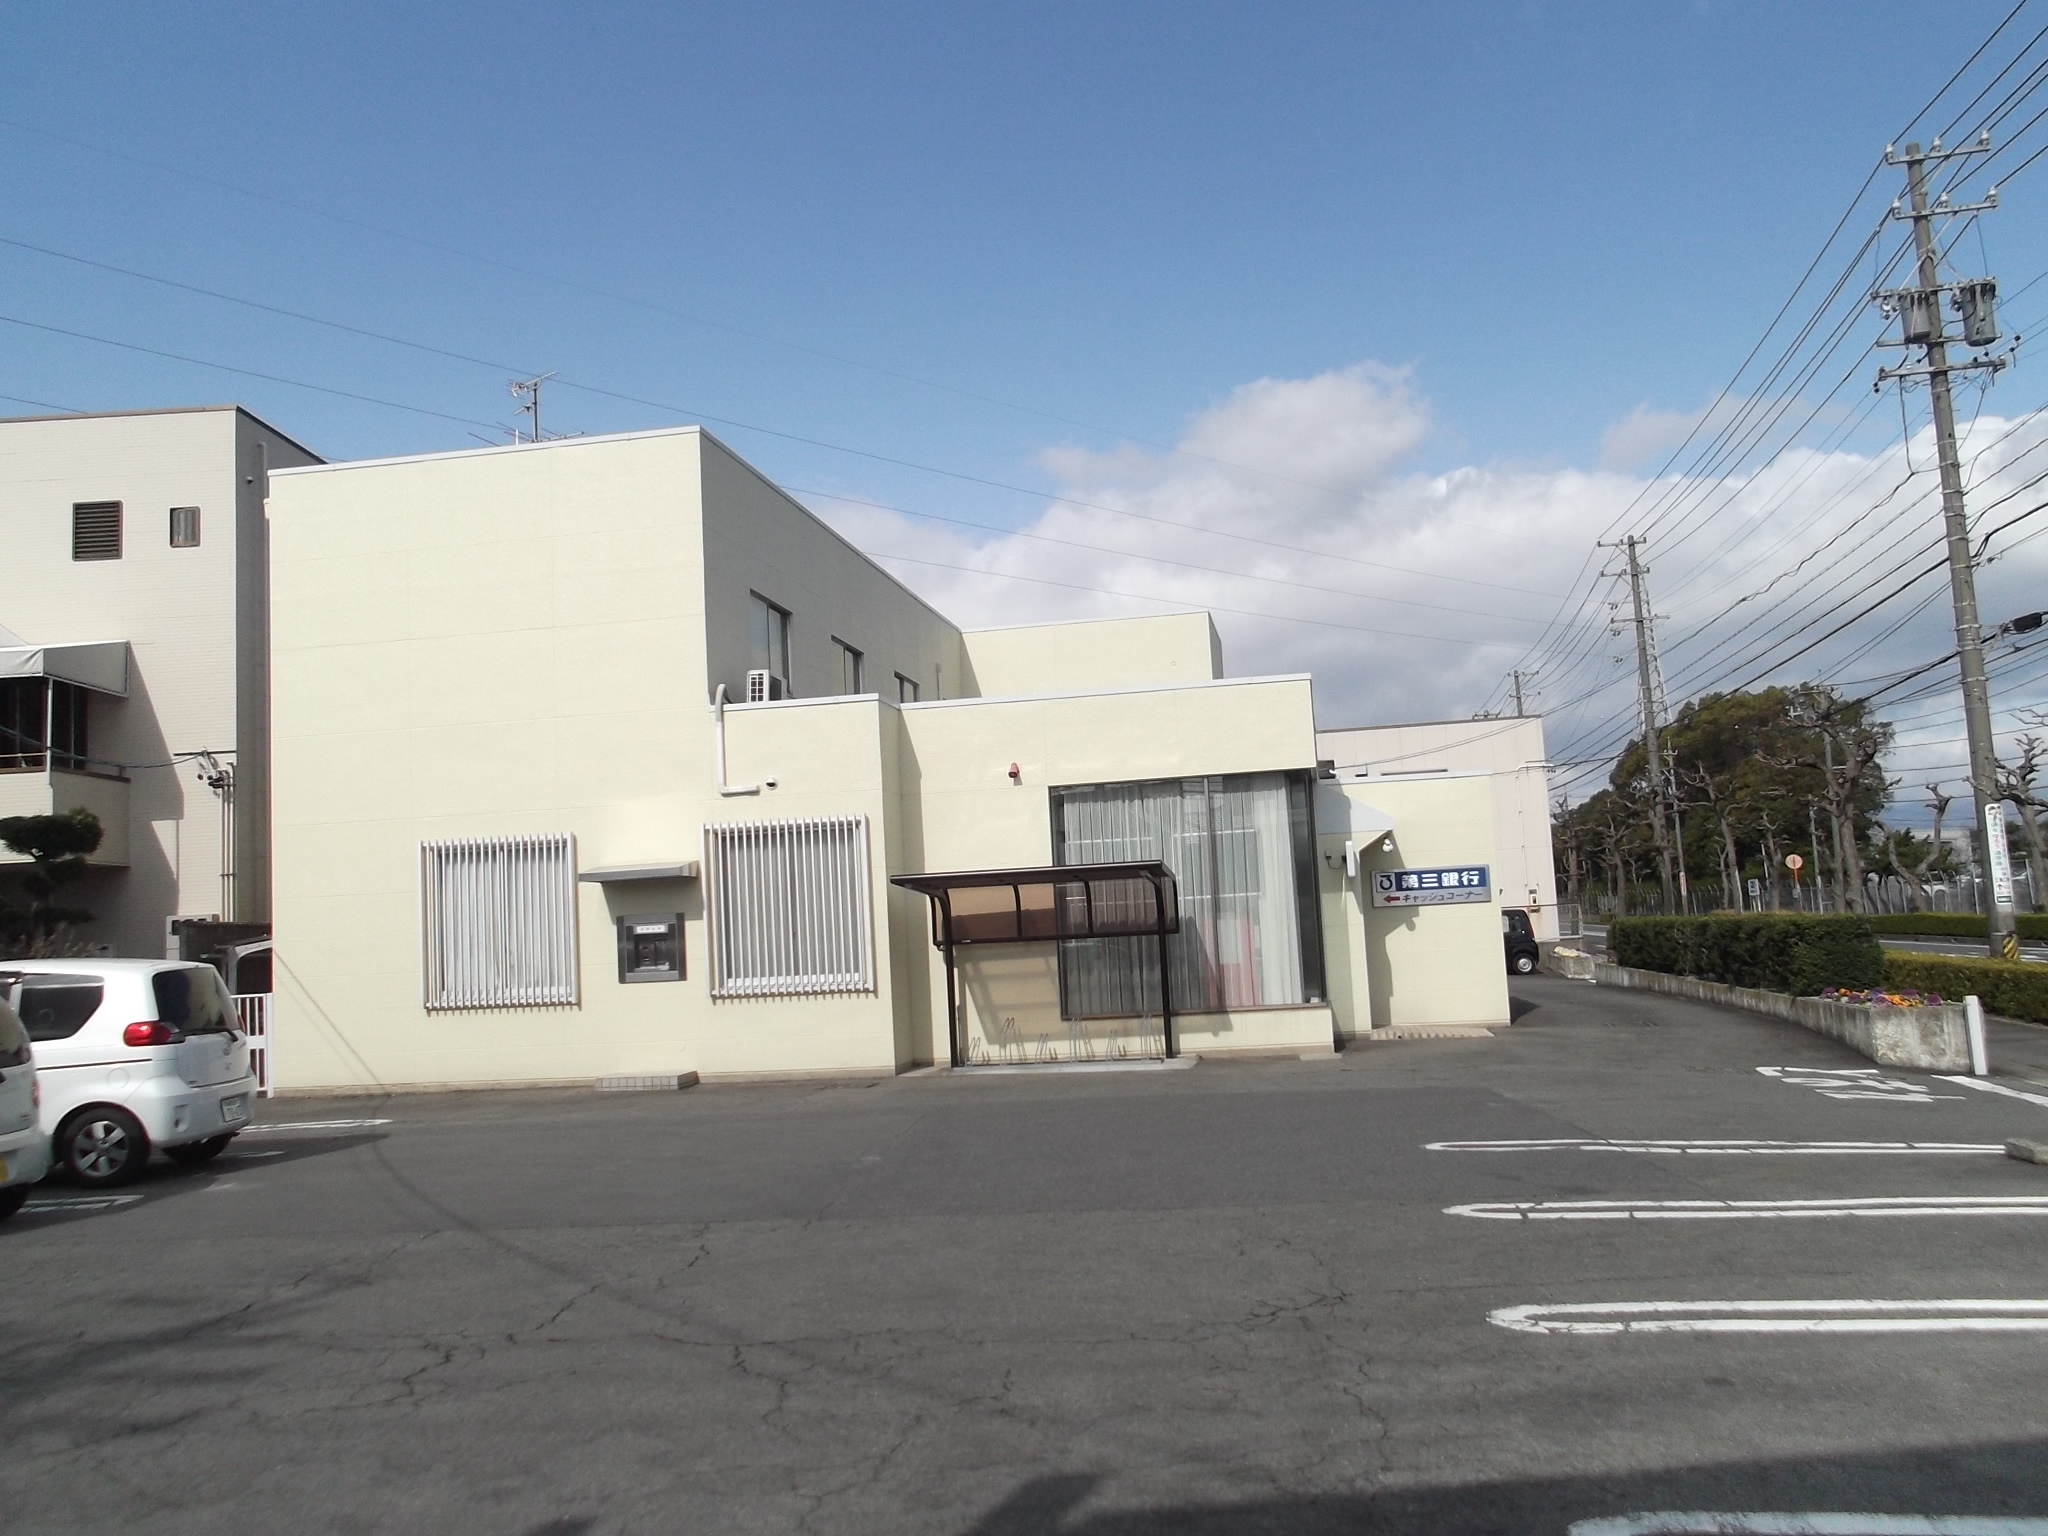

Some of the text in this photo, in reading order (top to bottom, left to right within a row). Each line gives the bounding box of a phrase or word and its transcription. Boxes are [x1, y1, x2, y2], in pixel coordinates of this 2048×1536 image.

[1401, 871, 1479, 888] 第三銀行
[1401, 890, 1483, 903] キャッシュコーナー
